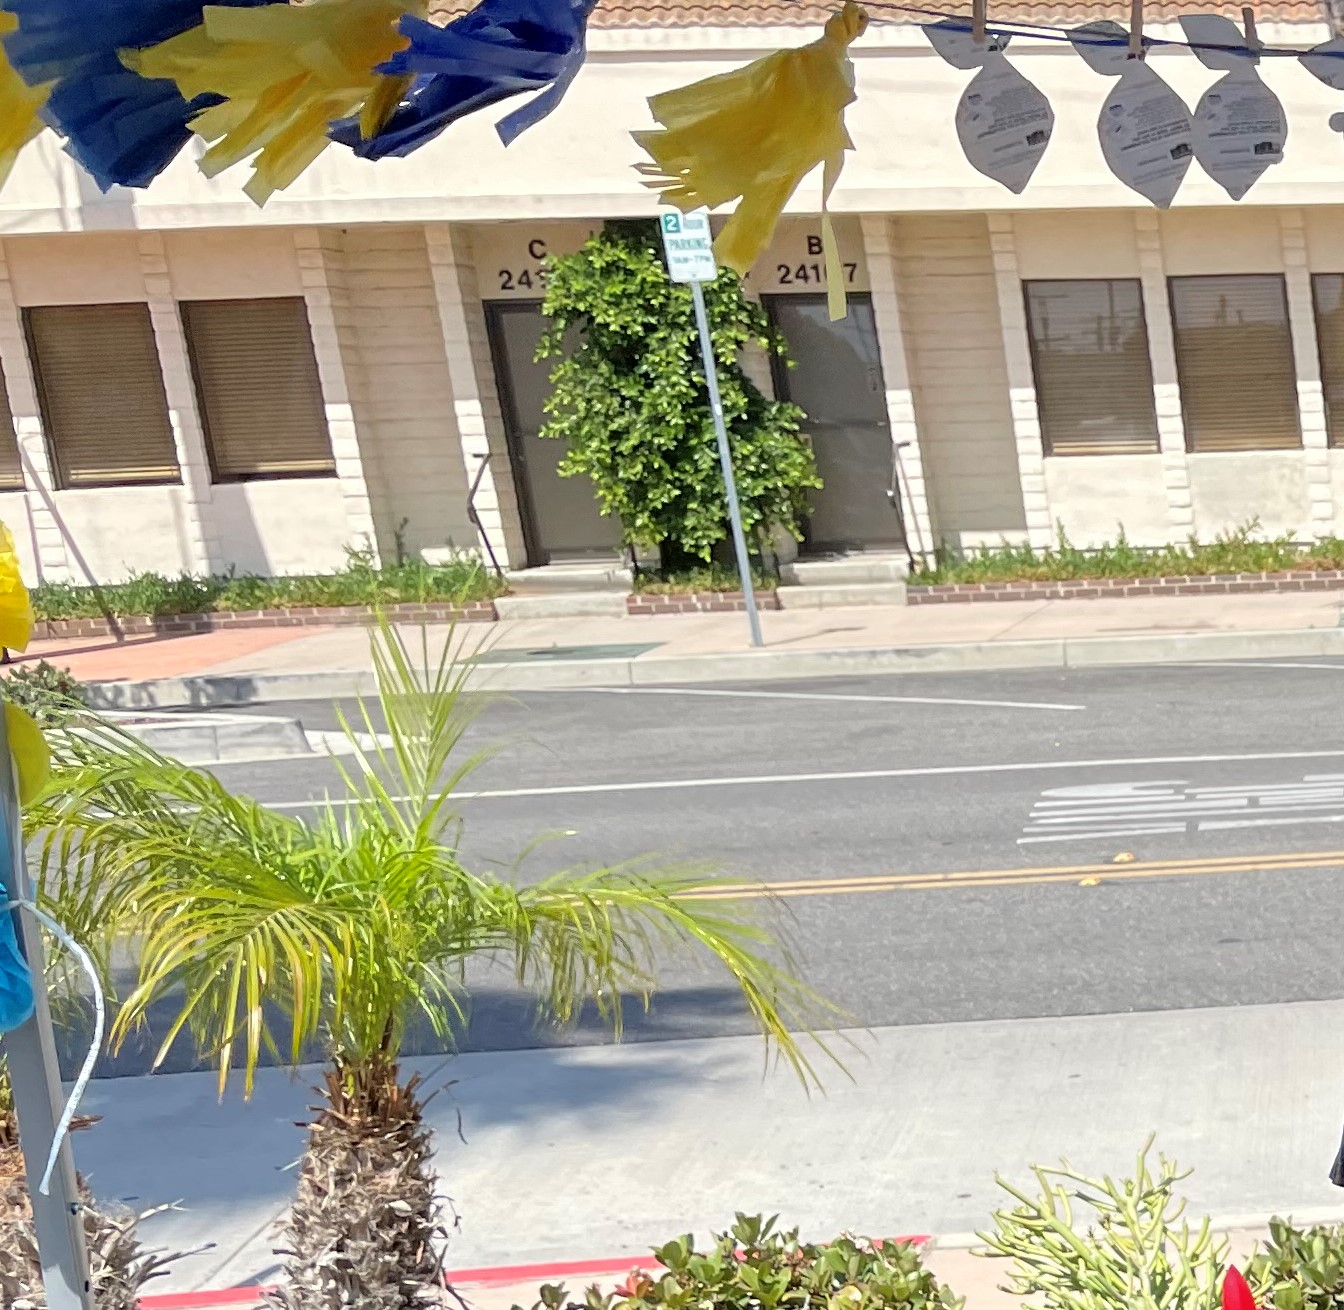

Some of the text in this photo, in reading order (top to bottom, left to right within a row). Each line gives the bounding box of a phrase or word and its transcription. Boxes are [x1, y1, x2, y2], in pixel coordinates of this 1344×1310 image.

[665, 216, 677, 230] 2
[528, 239, 547, 260] C
[808, 236, 823, 255] B
[778, 264, 857, 284] 2417
